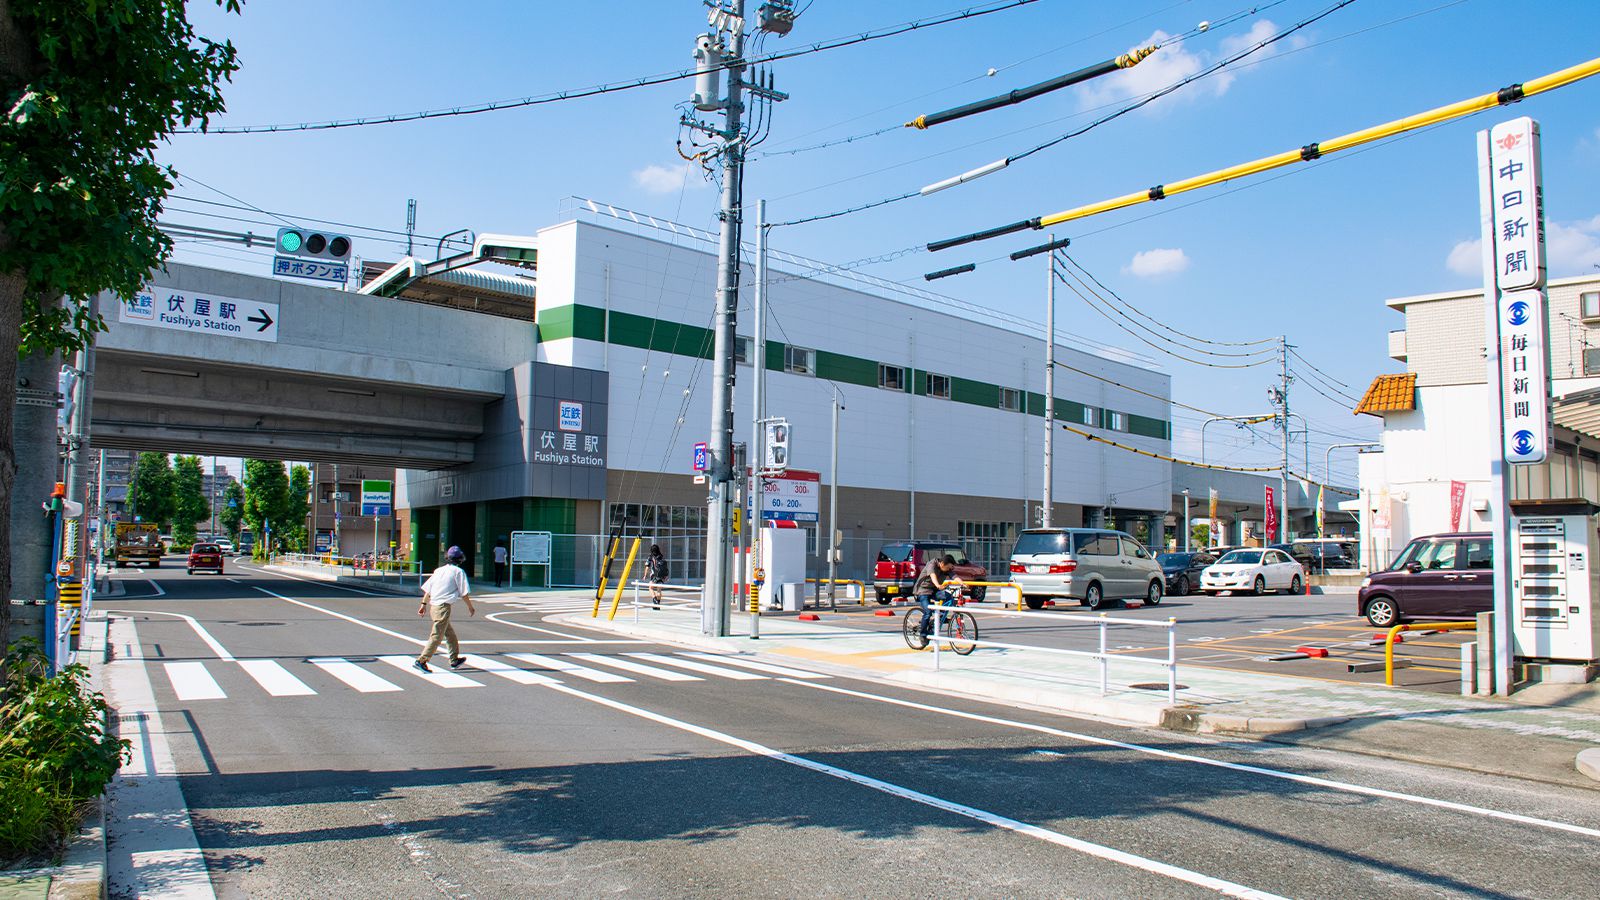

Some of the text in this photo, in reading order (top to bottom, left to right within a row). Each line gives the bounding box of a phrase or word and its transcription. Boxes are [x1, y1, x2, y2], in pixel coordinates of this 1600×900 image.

[1499, 159, 1529, 276] 中日新聞
[276, 259, 345, 281] 押ボタン式
[167, 294, 237, 320] 伏屋駅
[160, 312, 241, 333] Fushiya Station
[1511, 333, 1529, 419] 毎日新聞
[561, 406, 581, 419] 近鉄
[540, 431, 598, 453] 伏屋駅
[534, 451, 603, 466] Fushiya Station
